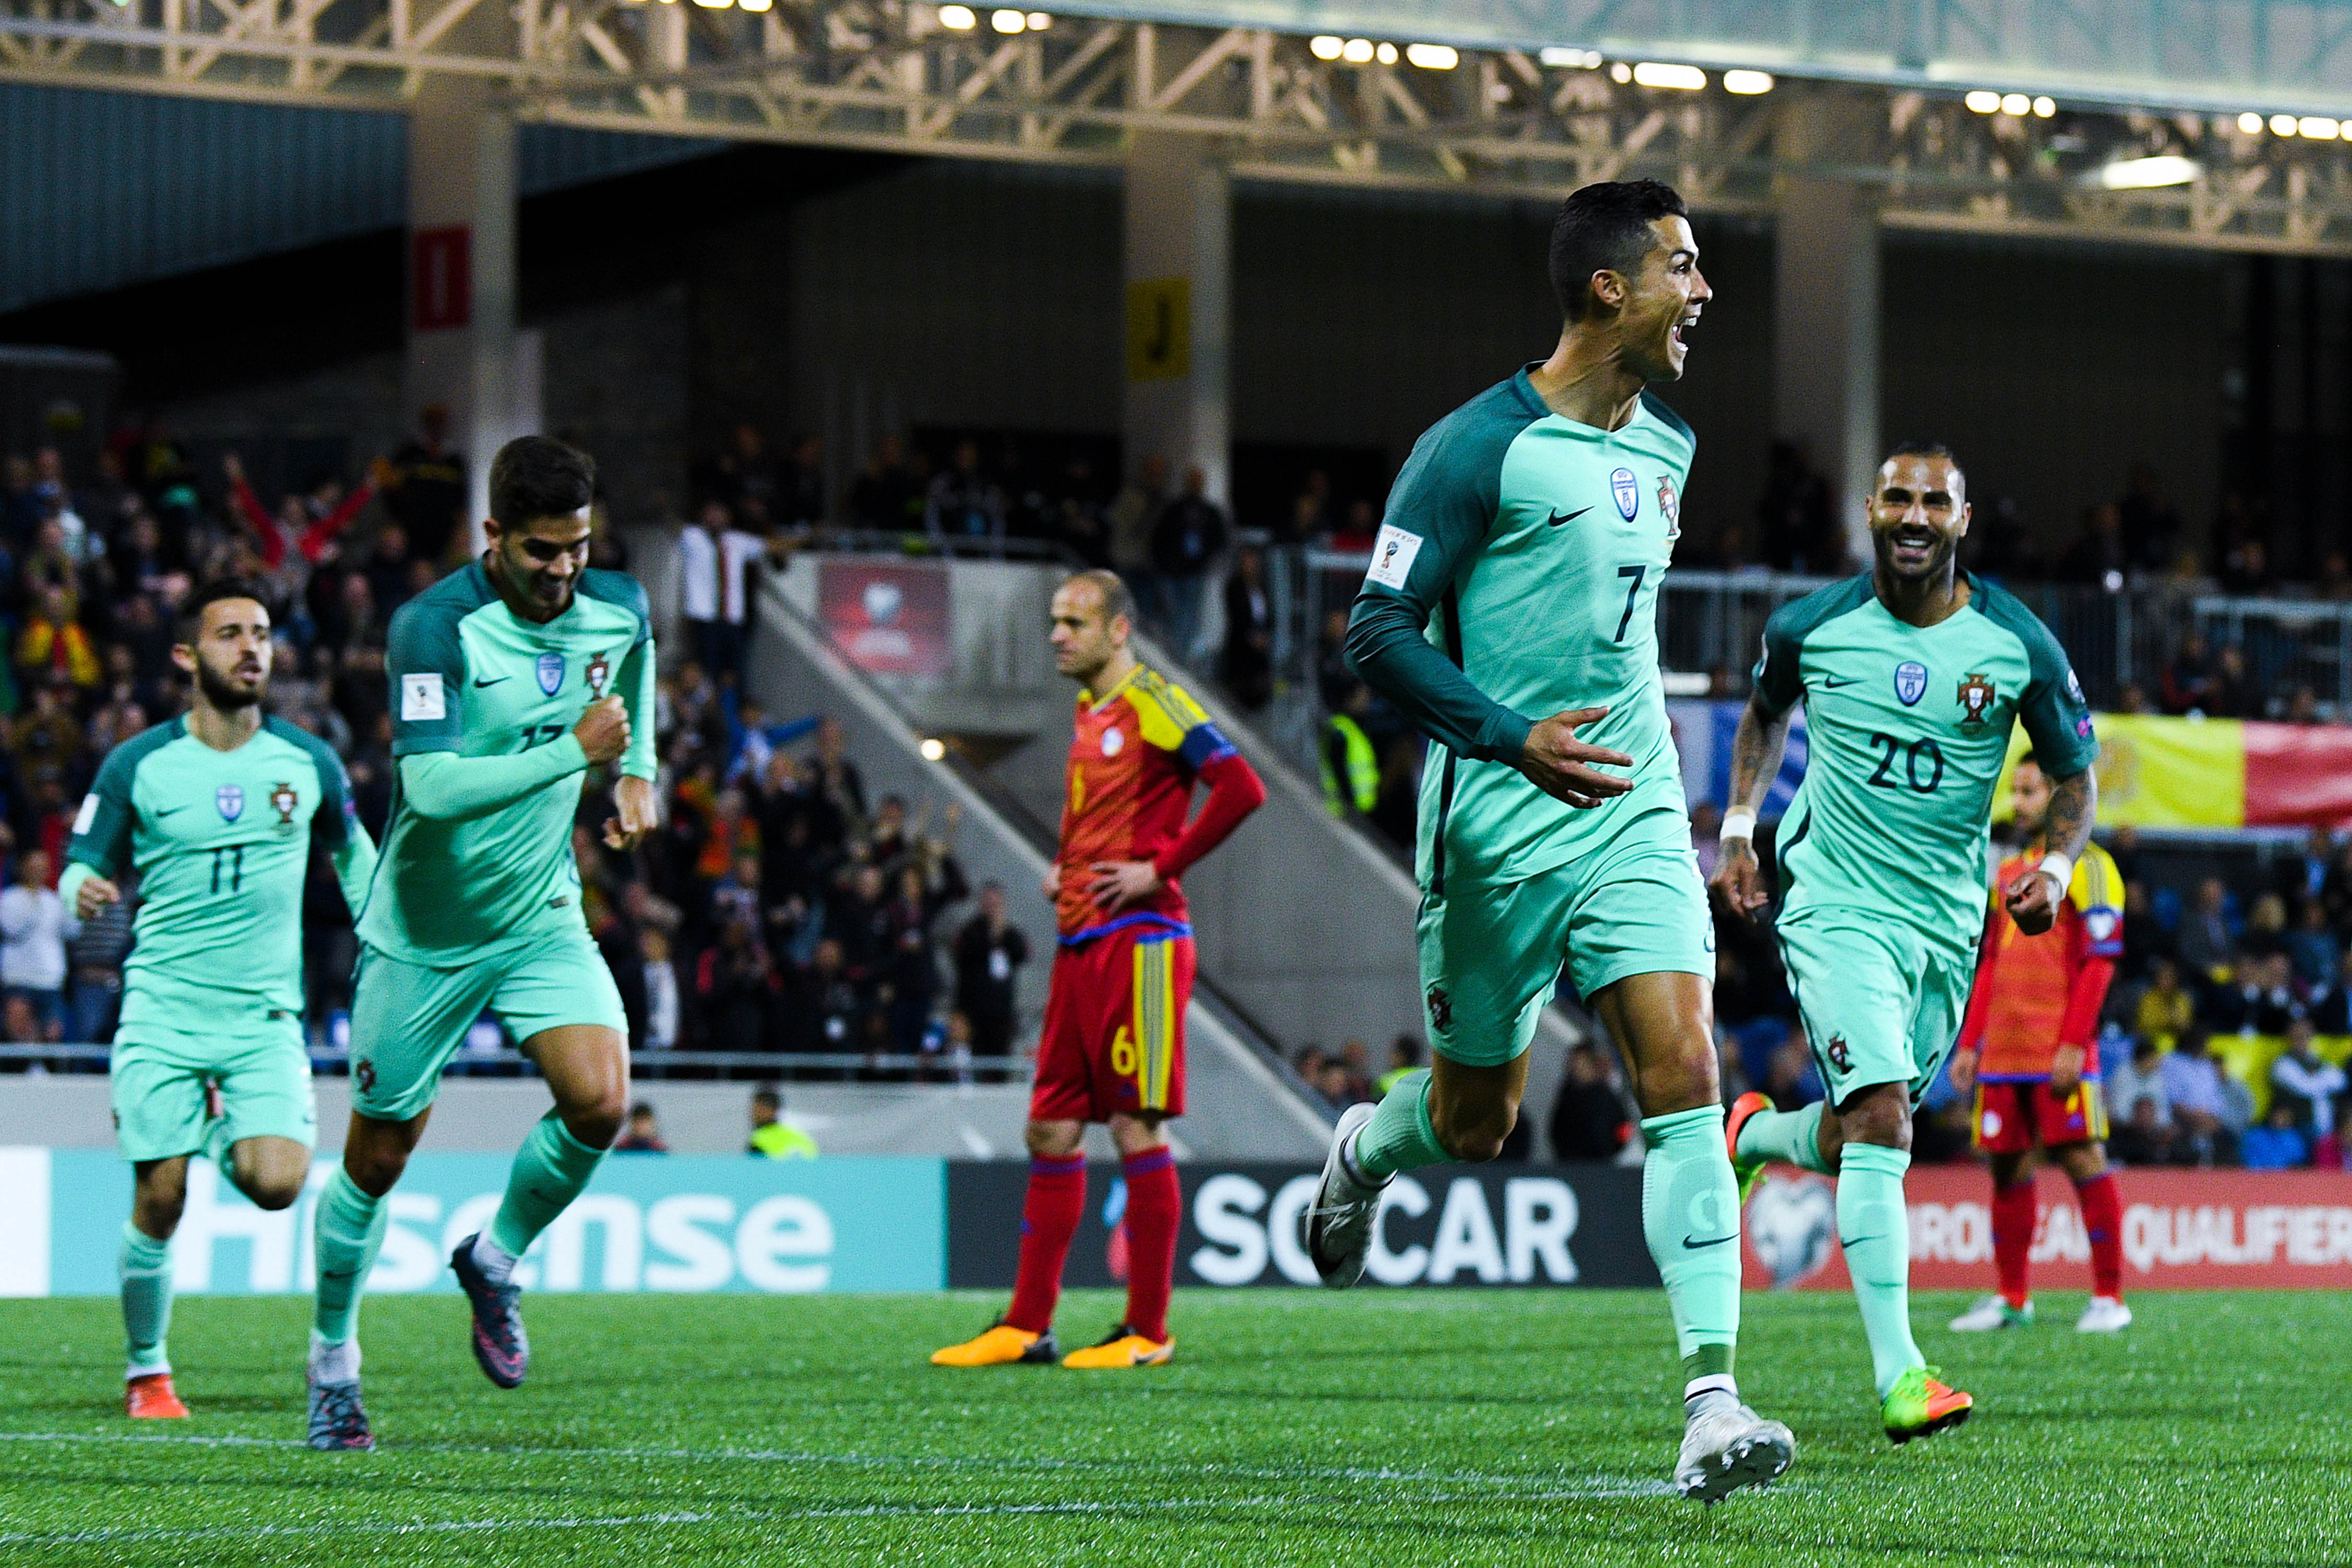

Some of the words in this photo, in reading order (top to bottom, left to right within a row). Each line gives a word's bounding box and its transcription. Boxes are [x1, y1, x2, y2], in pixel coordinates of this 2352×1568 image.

[1148, 294, 1171, 361] J
[1613, 565, 1646, 642] 7
[1867, 732, 1944, 793] 20
[211, 843, 245, 893] 11
[1111, 1024, 1137, 1076] 6
[1190, 1174, 1579, 1285] SOCAR
